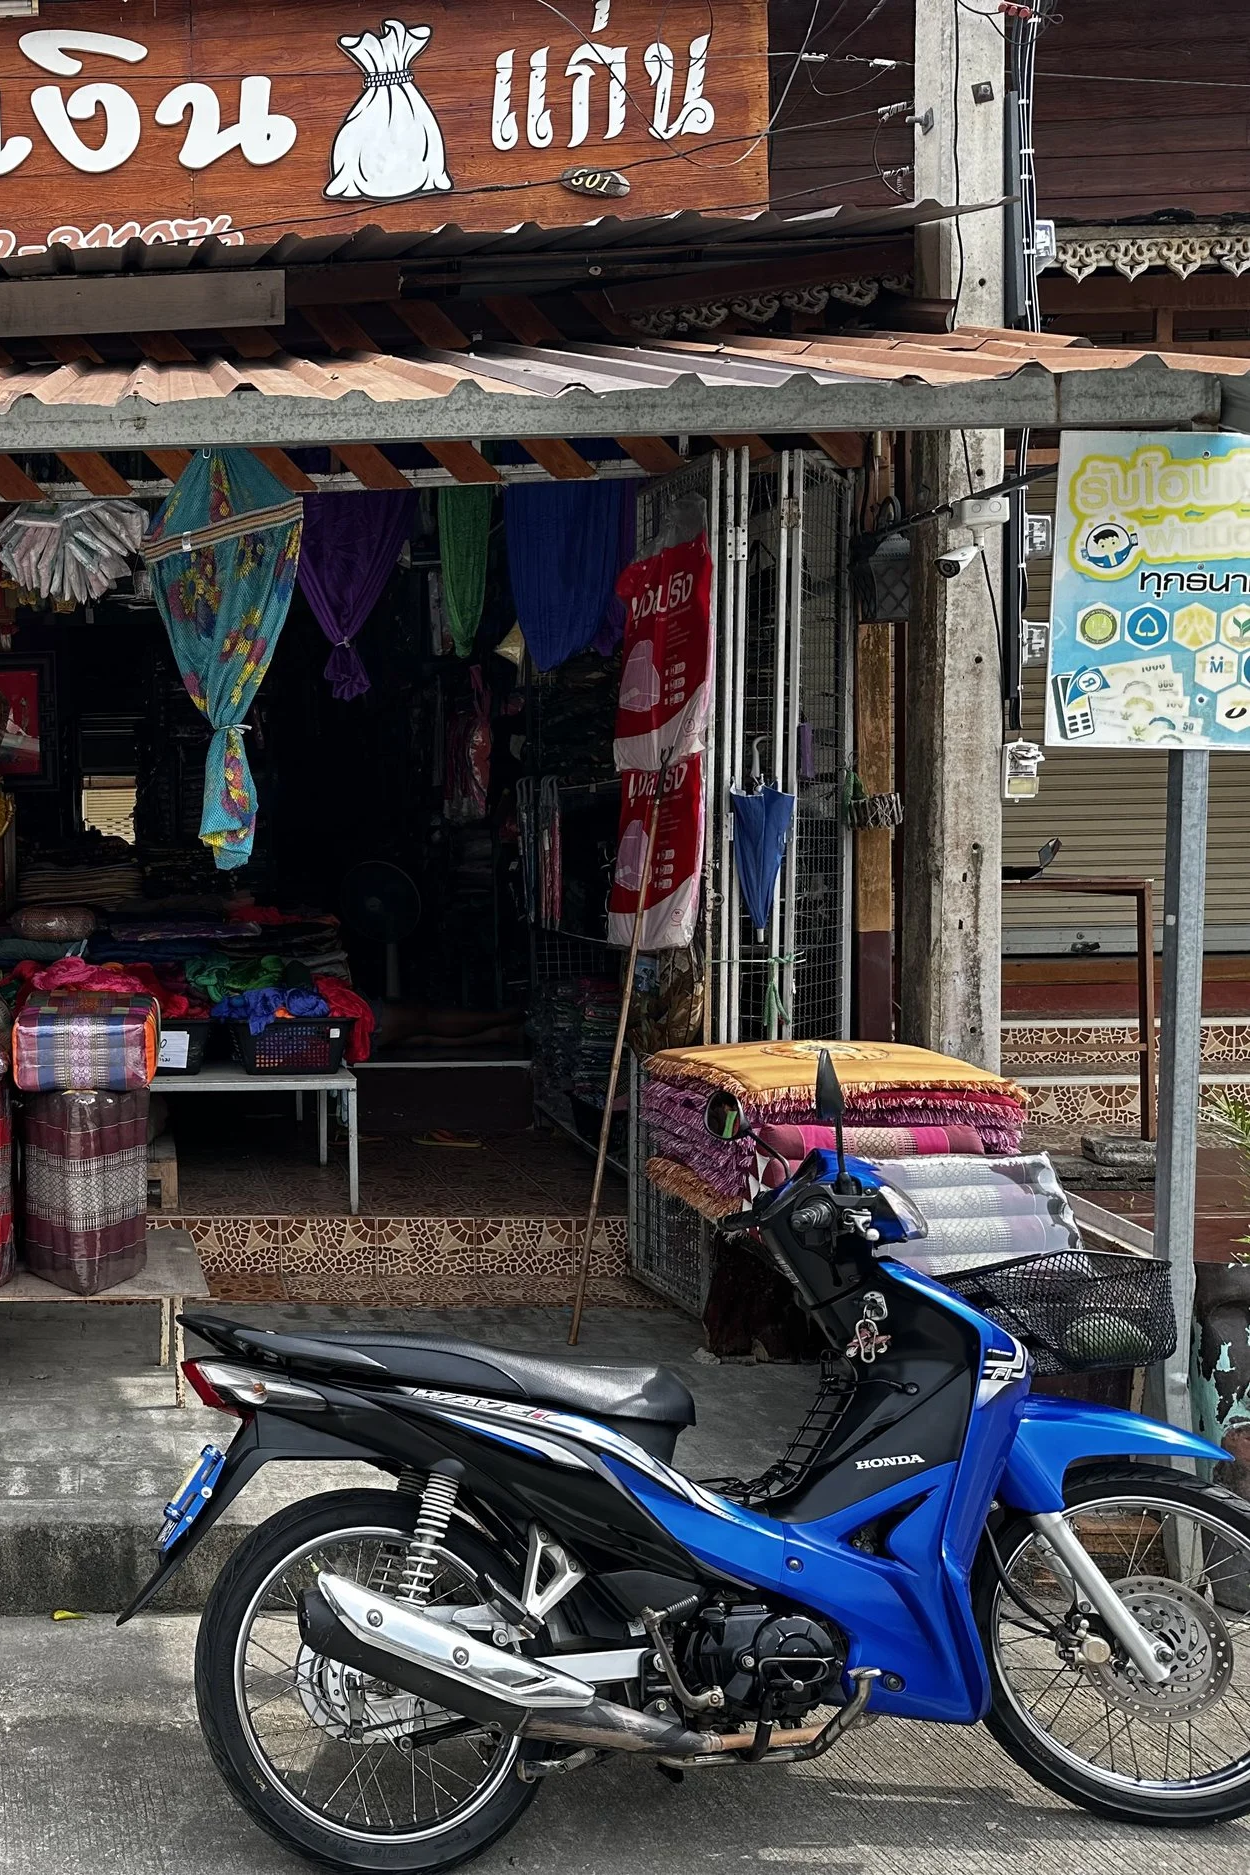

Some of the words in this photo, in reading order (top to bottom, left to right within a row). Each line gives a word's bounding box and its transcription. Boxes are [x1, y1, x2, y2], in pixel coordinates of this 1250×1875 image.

[491, 0, 716, 151] แก่น
[1140, 571, 1250, 599] ทุกธนา
[1182, 721, 1195, 731] 50
[990, 1367, 1013, 1381] FI
[854, 1454, 926, 1470] HONDA
